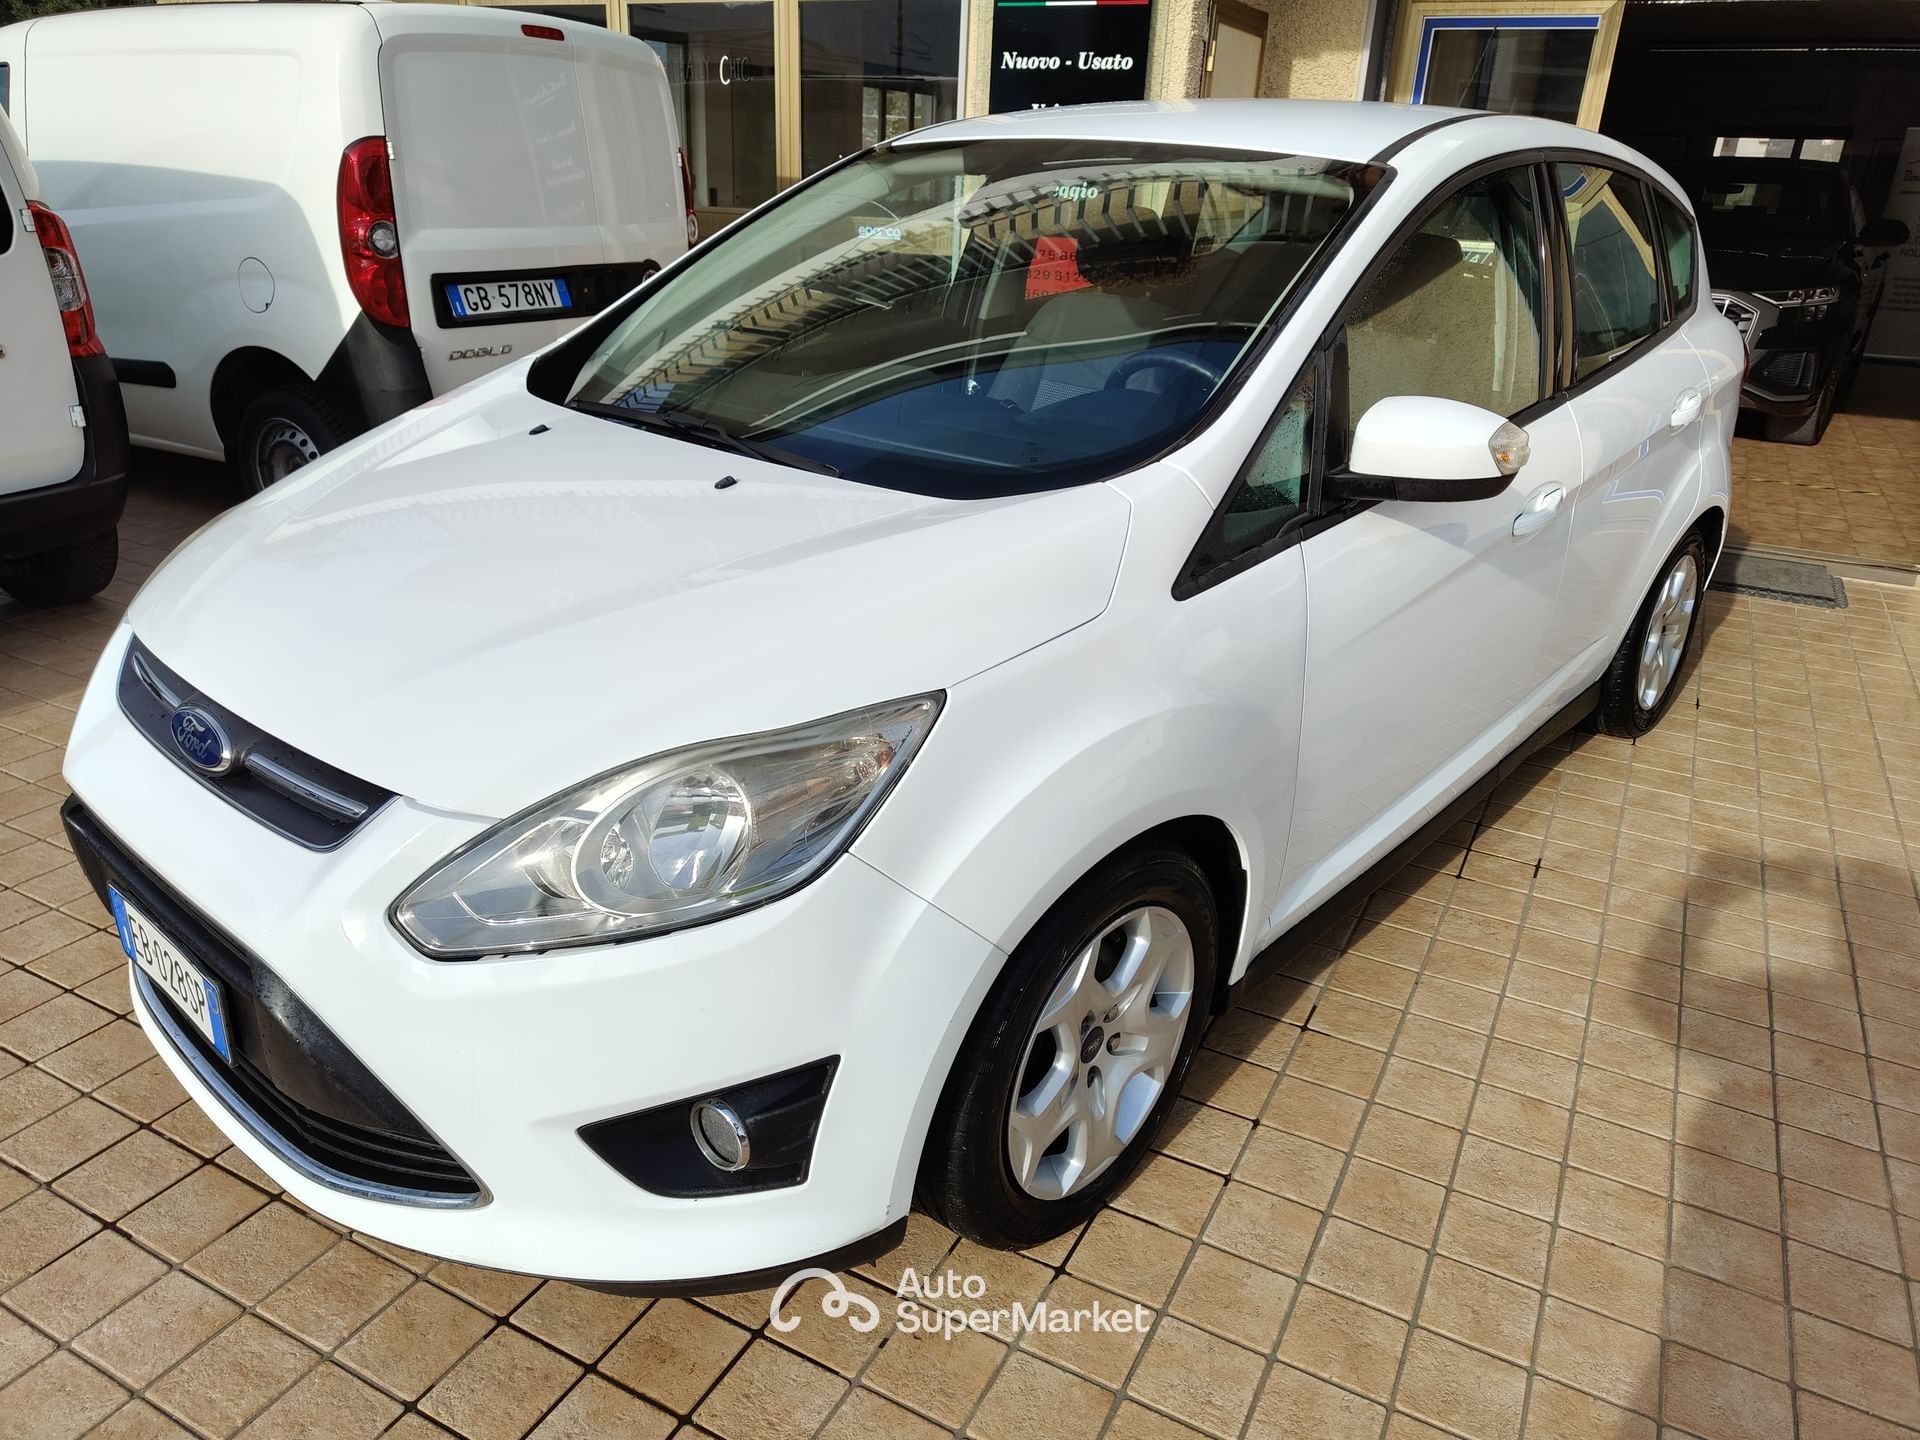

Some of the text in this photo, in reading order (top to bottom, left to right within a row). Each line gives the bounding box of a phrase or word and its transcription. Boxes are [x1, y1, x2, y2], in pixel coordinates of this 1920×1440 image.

[1000, 51, 1061, 70] Nuovo
[1077, 51, 1134, 70] Usato
[463, 286, 492, 312] GB
[498, 282, 557, 309] 578NY
[177, 715, 212, 759] Ford
[127, 913, 153, 967] EB
[152, 938, 205, 1021] 028SP
